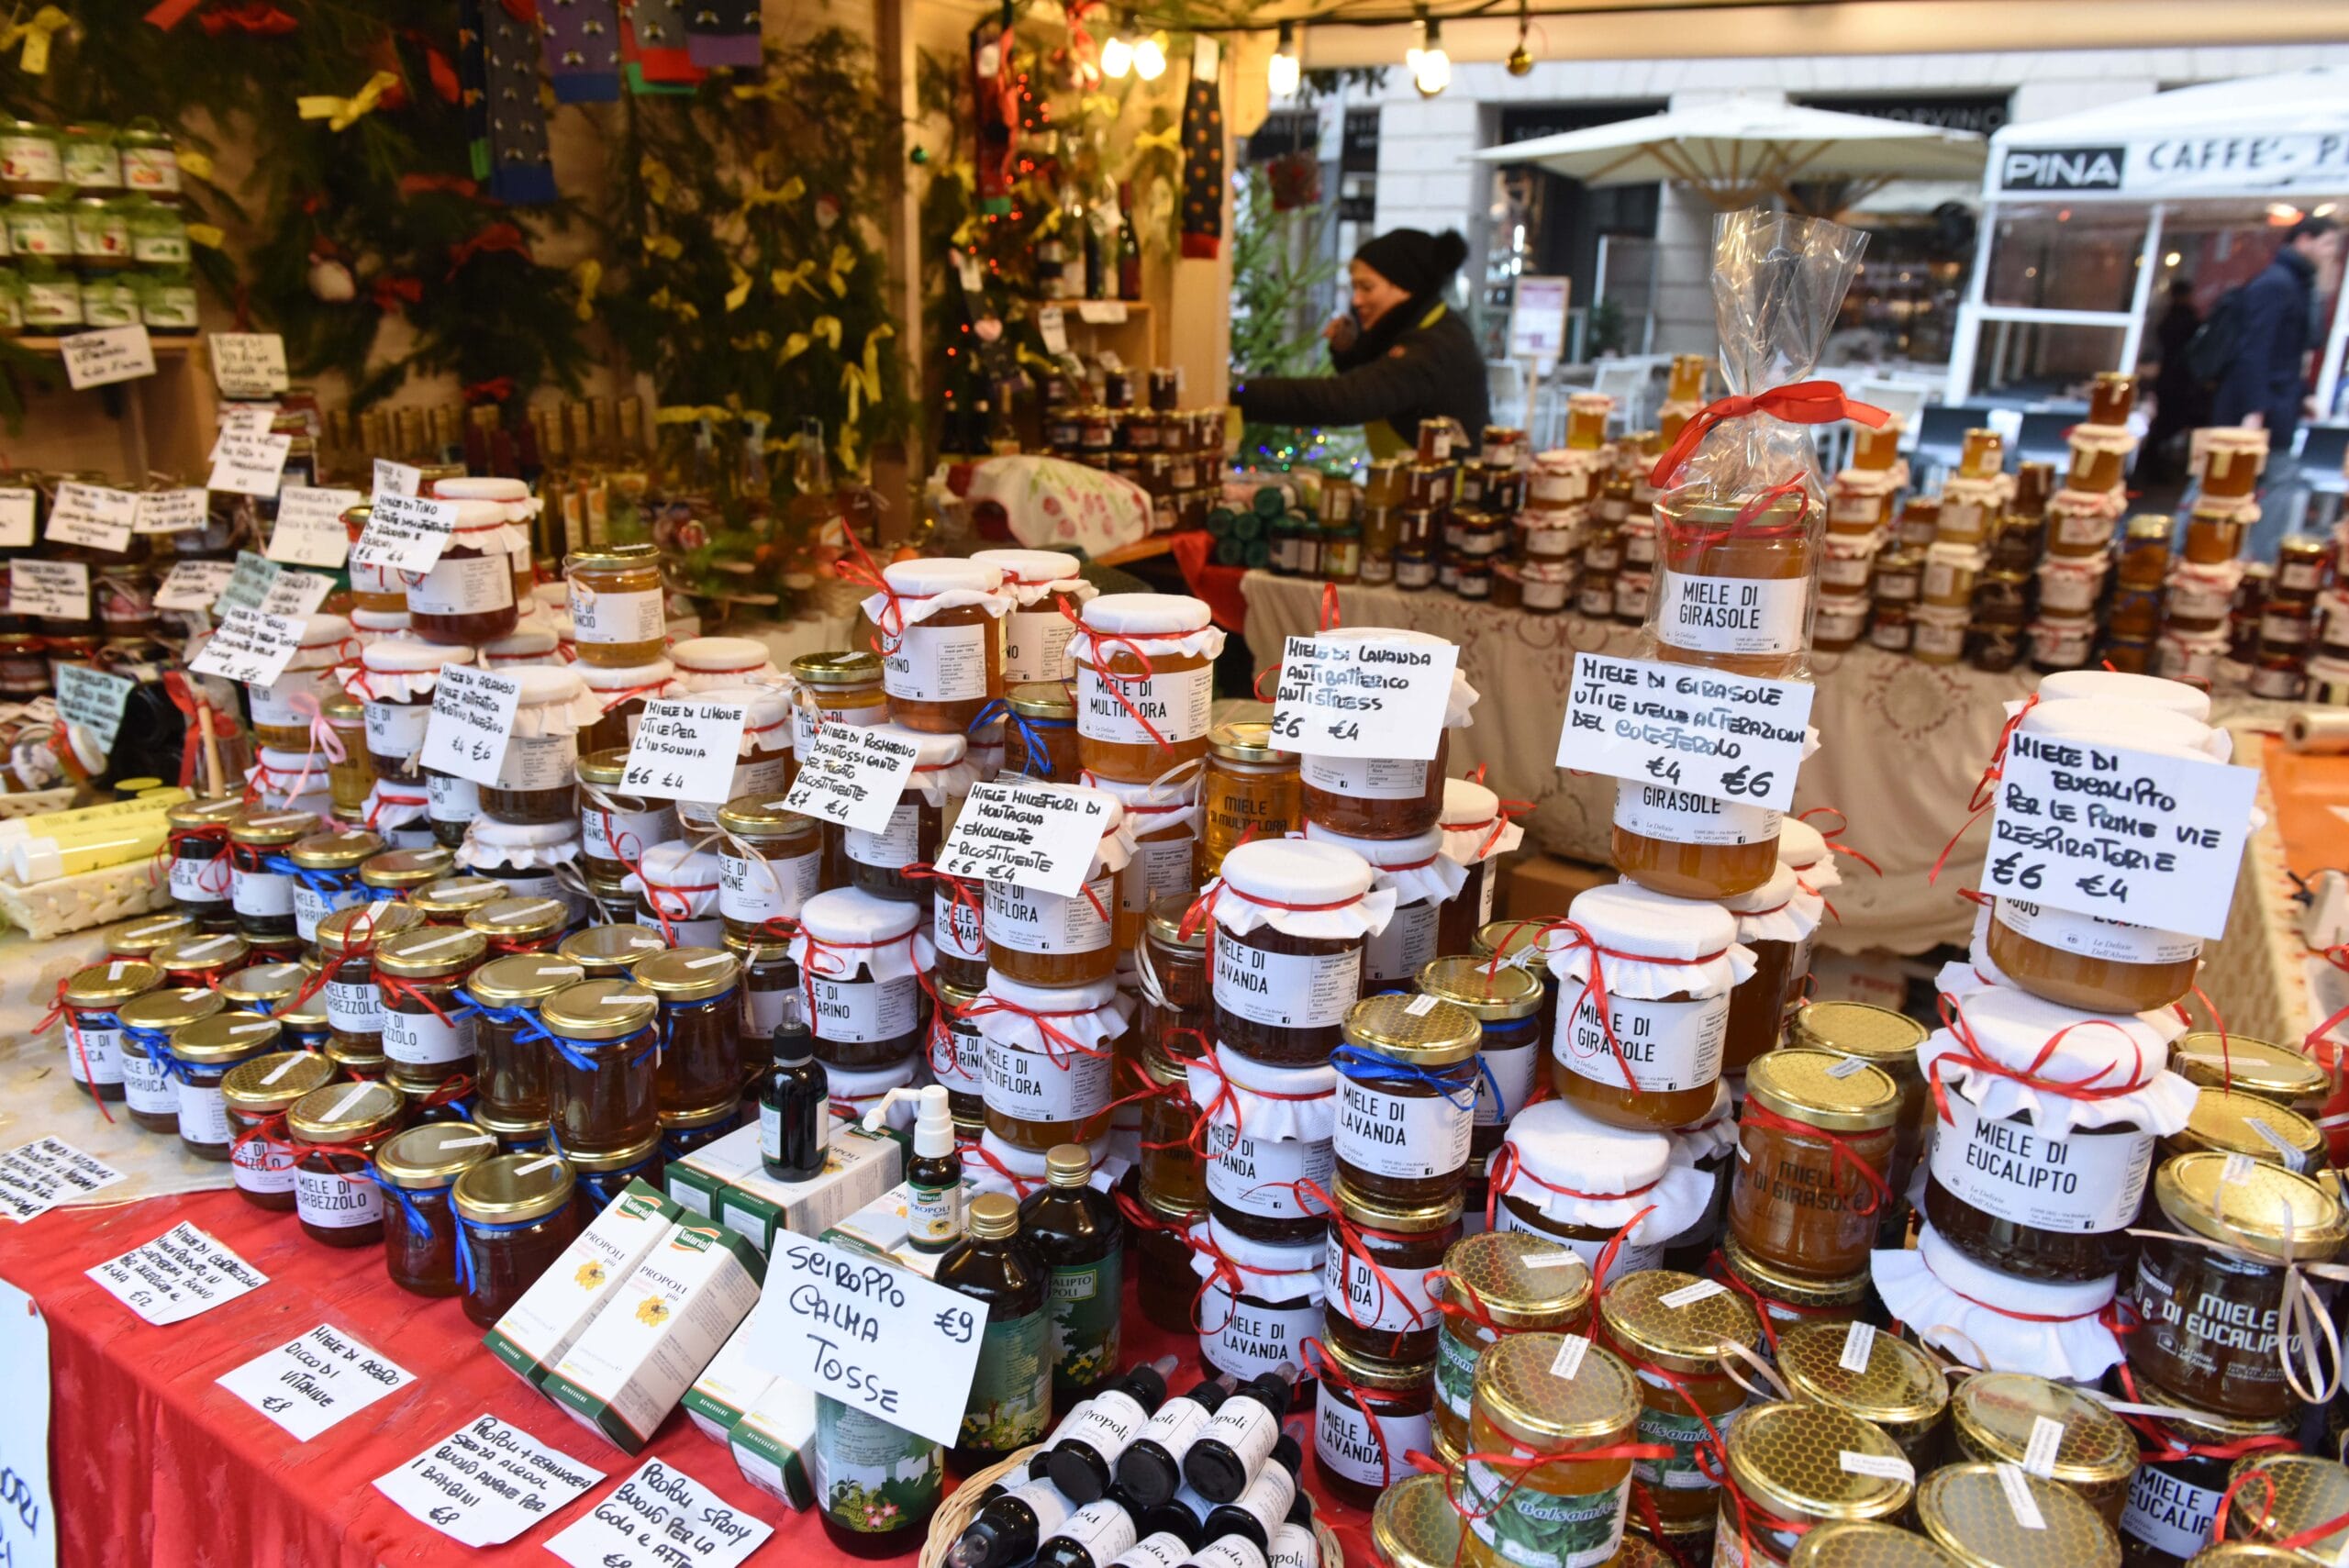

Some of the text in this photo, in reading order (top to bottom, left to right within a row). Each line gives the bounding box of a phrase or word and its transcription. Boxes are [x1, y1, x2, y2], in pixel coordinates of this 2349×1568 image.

[2003, 153, 2119, 186] PINA
[1683, 581, 1758, 606] MIELE DI
[1679, 604, 1761, 629] GIRASOLE
[1288, 638, 1431, 666] MIELE DI LAVANDA
[466, 675, 473, 685] DI
[1140, 679, 1152, 696] DI
[1286, 663, 1409, 690] ANTIBATTERICO
[1583, 658, 1784, 706] MIELE DI GIRASOLE
[649, 702, 741, 720] MIELE DI LIMONE
[1277, 683, 1383, 710] ANTISTRESS
[640, 717, 697, 739] UTILE PER
[1272, 711, 1359, 740] €6 €4
[1575, 682, 1627, 713] UTILE
[1693, 707, 1805, 743] ALTERAZIONI
[636, 736, 707, 758] L'INSONNIA
[821, 723, 916, 758] MIELE DI ROSMARINO
[1572, 709, 1742, 760] DEL COLESTEROLO
[473, 741, 492, 760] €6
[813, 740, 900, 772] DISINTOSSICANTE
[2013, 732, 2119, 772] MIELE DI
[628, 767, 653, 784] €6
[823, 760, 855, 779] FEGATO
[1646, 756, 1774, 797] €4 €6
[797, 772, 868, 802] RICOSTITUENTE
[971, 785, 1007, 802] MIELE
[1086, 801, 1100, 816] DI
[1643, 786, 1721, 814] GIRASOLE
[2051, 770, 2177, 812] EUCALIPTO
[825, 800, 849, 820] €4
[978, 804, 1044, 825] MONTAGNA
[1224, 796, 1267, 815] MIELE
[2006, 783, 2221, 849] PER LE PRIME VIE
[1997, 819, 2177, 873] RESPIRATORIE
[985, 864, 1017, 883] €4
[1991, 851, 2129, 903] €6 €4
[1013, 882, 1024, 900] DI
[1218, 935, 1265, 971] MIELE DI
[356, 985, 368, 999] DI
[1217, 961, 1269, 995] LAVANDA
[1579, 1003, 1650, 1038] MIEE DI
[1017, 1058, 1028, 1074] DI
[1343, 1084, 1405, 1122] MIELE DI
[1340, 1109, 1406, 1147] LAVANDA
[1975, 1118, 2068, 1165] MIELE DI
[1209, 1145, 1256, 1179] LAVANDA
[1241, 1140, 1254, 1157] DI
[1965, 1143, 2077, 1195] EUCALIPTO
[299, 1177, 351, 1194] MIELE DI
[911, 1203, 951, 1213] PROPOLI
[584, 1230, 626, 1262] PROPOLI
[639, 1265, 687, 1295] PROPOLI
[789, 1284, 974, 1343] CALMA €9
[1224, 1310, 1285, 1339] MIELE DI
[2163, 1303, 2181, 1326] DI
[2197, 1293, 2279, 1331] MIELE
[310, 1326, 346, 1354] MIELE
[342, 1348, 360, 1362] DI
[1222, 1334, 1288, 1360] LAVANDA
[284, 1342, 340, 1378] RICCO DI
[807, 1333, 899, 1413] TOSSE
[280, 1370, 335, 1407] VITAMINE
[560, 1385, 588, 1404] BENESSERE
[262, 1396, 293, 1413] €8
[699, 1398, 729, 1418] BENESSERE
[473, 1417, 520, 1453] PROPOLI
[1323, 1406, 1358, 1439] MIELE
[746, 1432, 778, 1452] BENESSERE
[1320, 1426, 1385, 1465] LAVANDA
[451, 1433, 547, 1490] SENZA ALCOOL
[420, 1467, 482, 1507] BAMBINI
[435, 1445, 546, 1513] BUONO ANCHE PER
[2138, 1467, 2202, 1510] MIELE
[429, 1507, 460, 1525] €8
[595, 1504, 635, 1536] GOLA
[615, 1483, 715, 1555] BUONO PER LA
[640, 1463, 751, 1547] PROPOLI SPRAY
[1520, 1501, 1622, 1523] Balsamico
